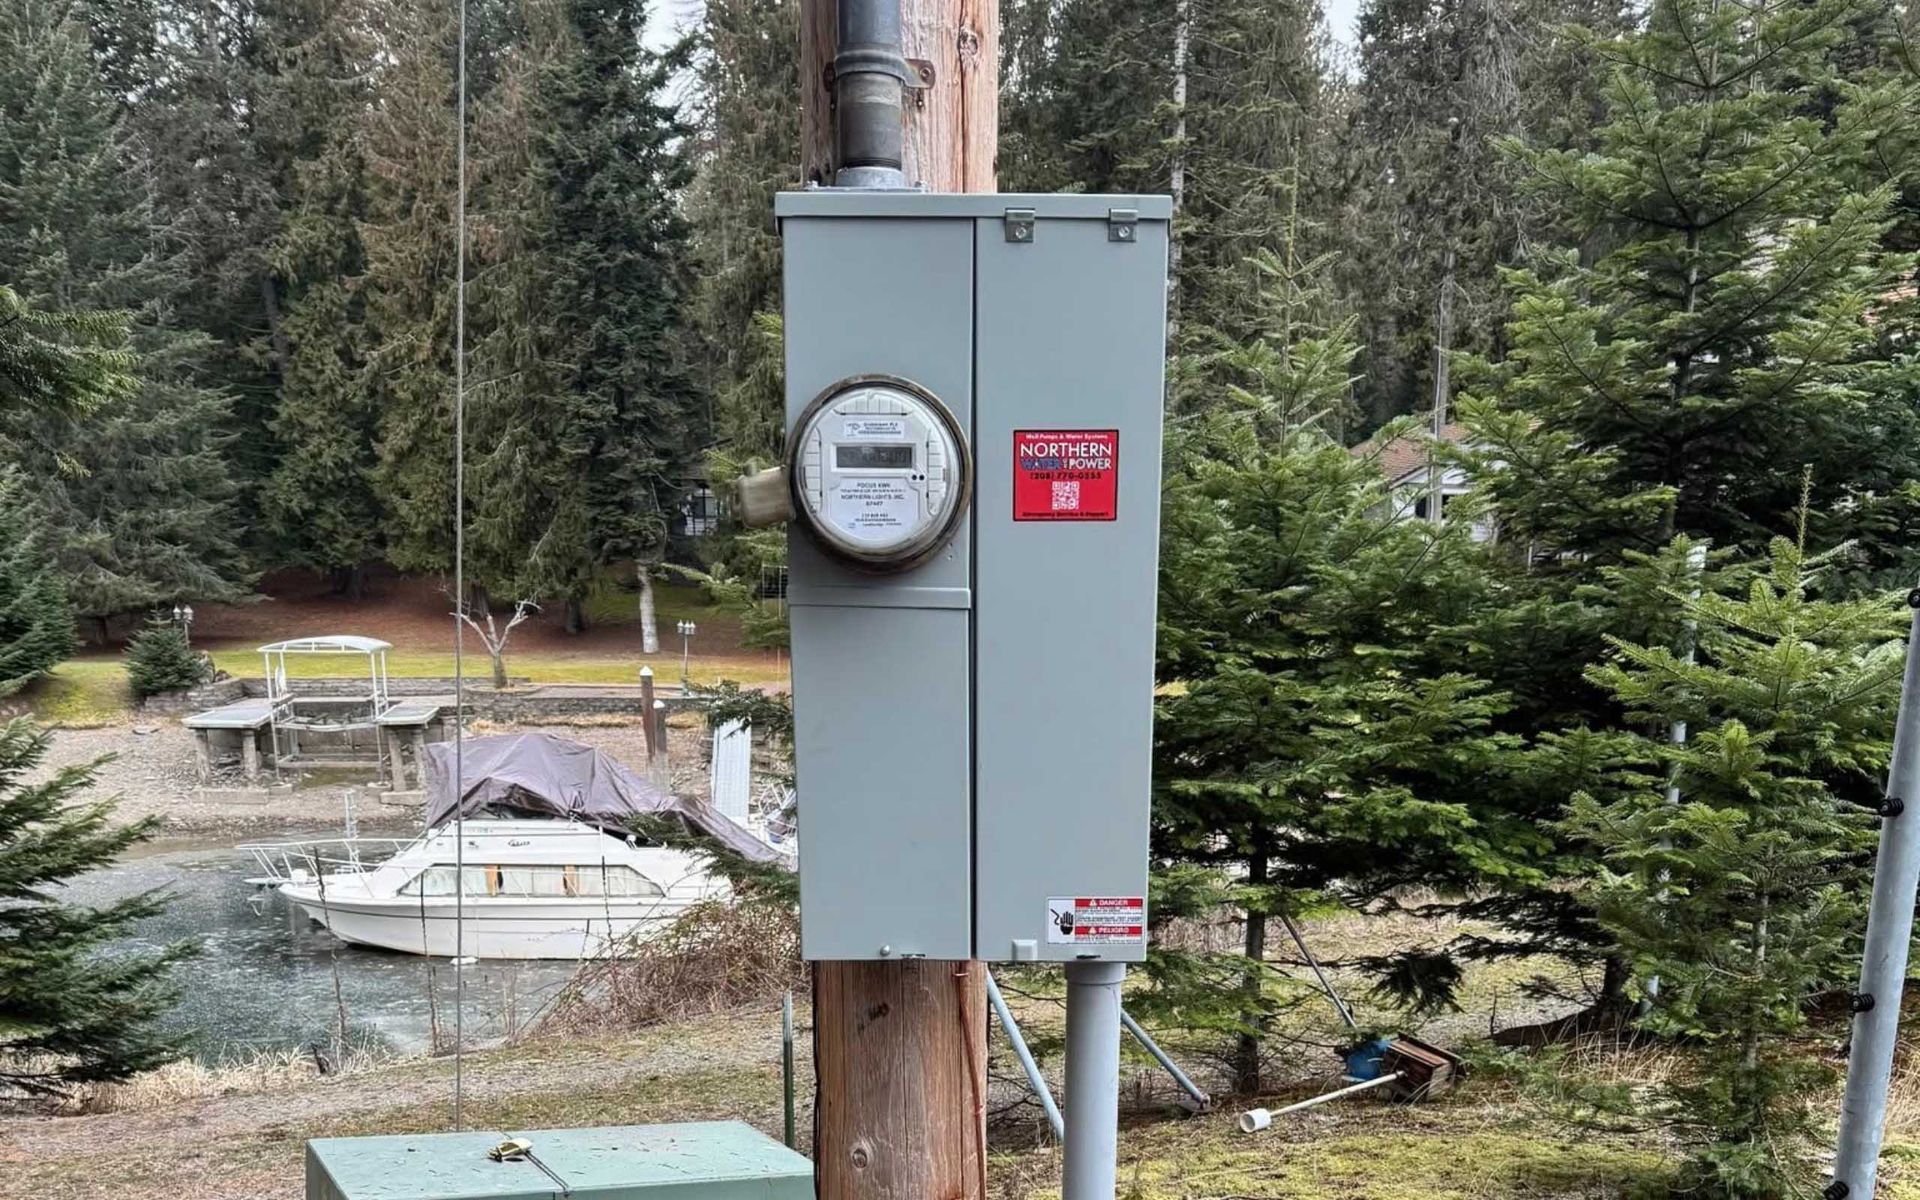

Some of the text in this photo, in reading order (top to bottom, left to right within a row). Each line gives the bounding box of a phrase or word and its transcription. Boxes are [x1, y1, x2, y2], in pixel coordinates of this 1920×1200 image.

[1084, 433, 1108, 441] Systems
[1020, 442, 1112, 457] NORTHERN
[1020, 457, 1060, 470] WATER
[1068, 457, 1112, 470] POWER
